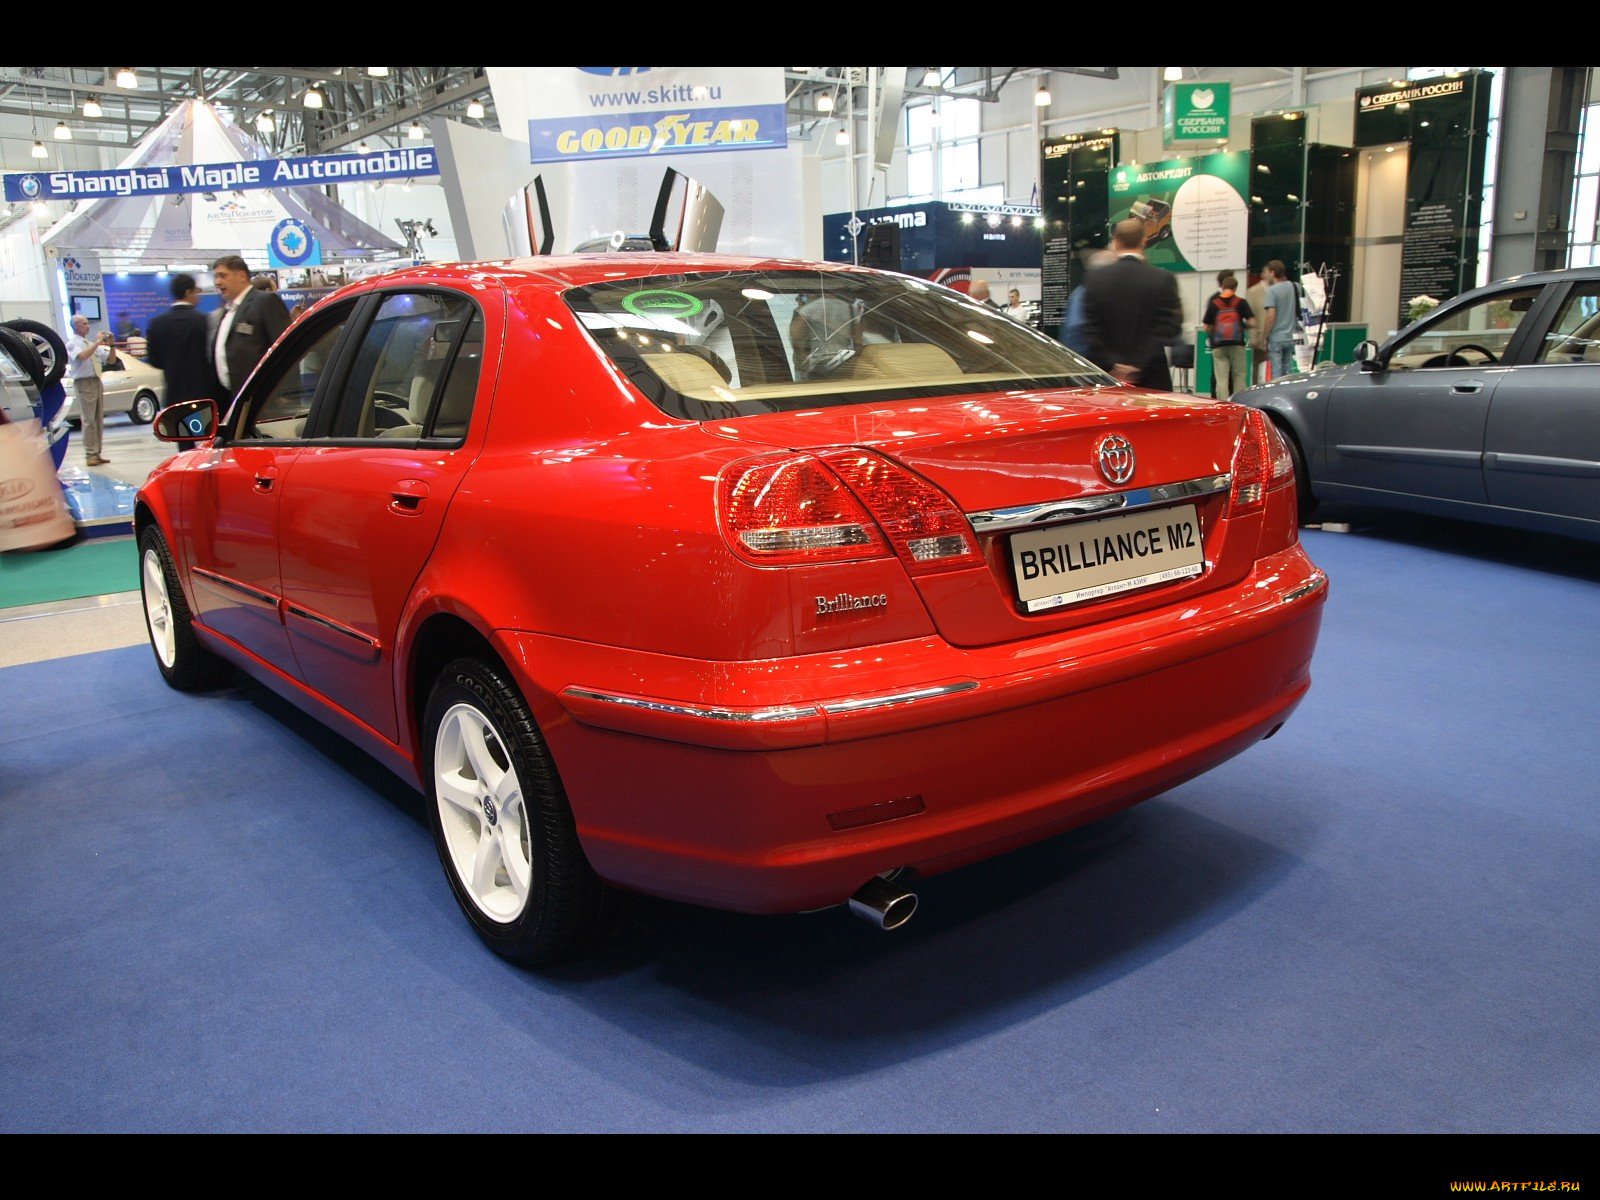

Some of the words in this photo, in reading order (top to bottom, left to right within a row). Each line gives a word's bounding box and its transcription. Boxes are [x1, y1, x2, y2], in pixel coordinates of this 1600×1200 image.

[1372, 88, 1421, 104] СБЕРБАНК
[1421, 81, 1464, 96] РОССИИ
[1177, 117, 1226, 126] СБЕРБАНК
[1182, 125, 1221, 134] РОССИИ
[556, 115, 759, 153] GOODYEAR
[50, 168, 170, 195] Shanghai
[181, 163, 260, 189] Maple
[273, 151, 433, 180] Automobile
[1136, 167, 1193, 183] АВТОКРЕДИТ
[1020, 528, 1164, 581] BRILLIANCE
[1168, 522, 1196, 550] M2
[815, 592, 888, 615] Brilliance
[1075, 588, 1104, 599] Импортер
